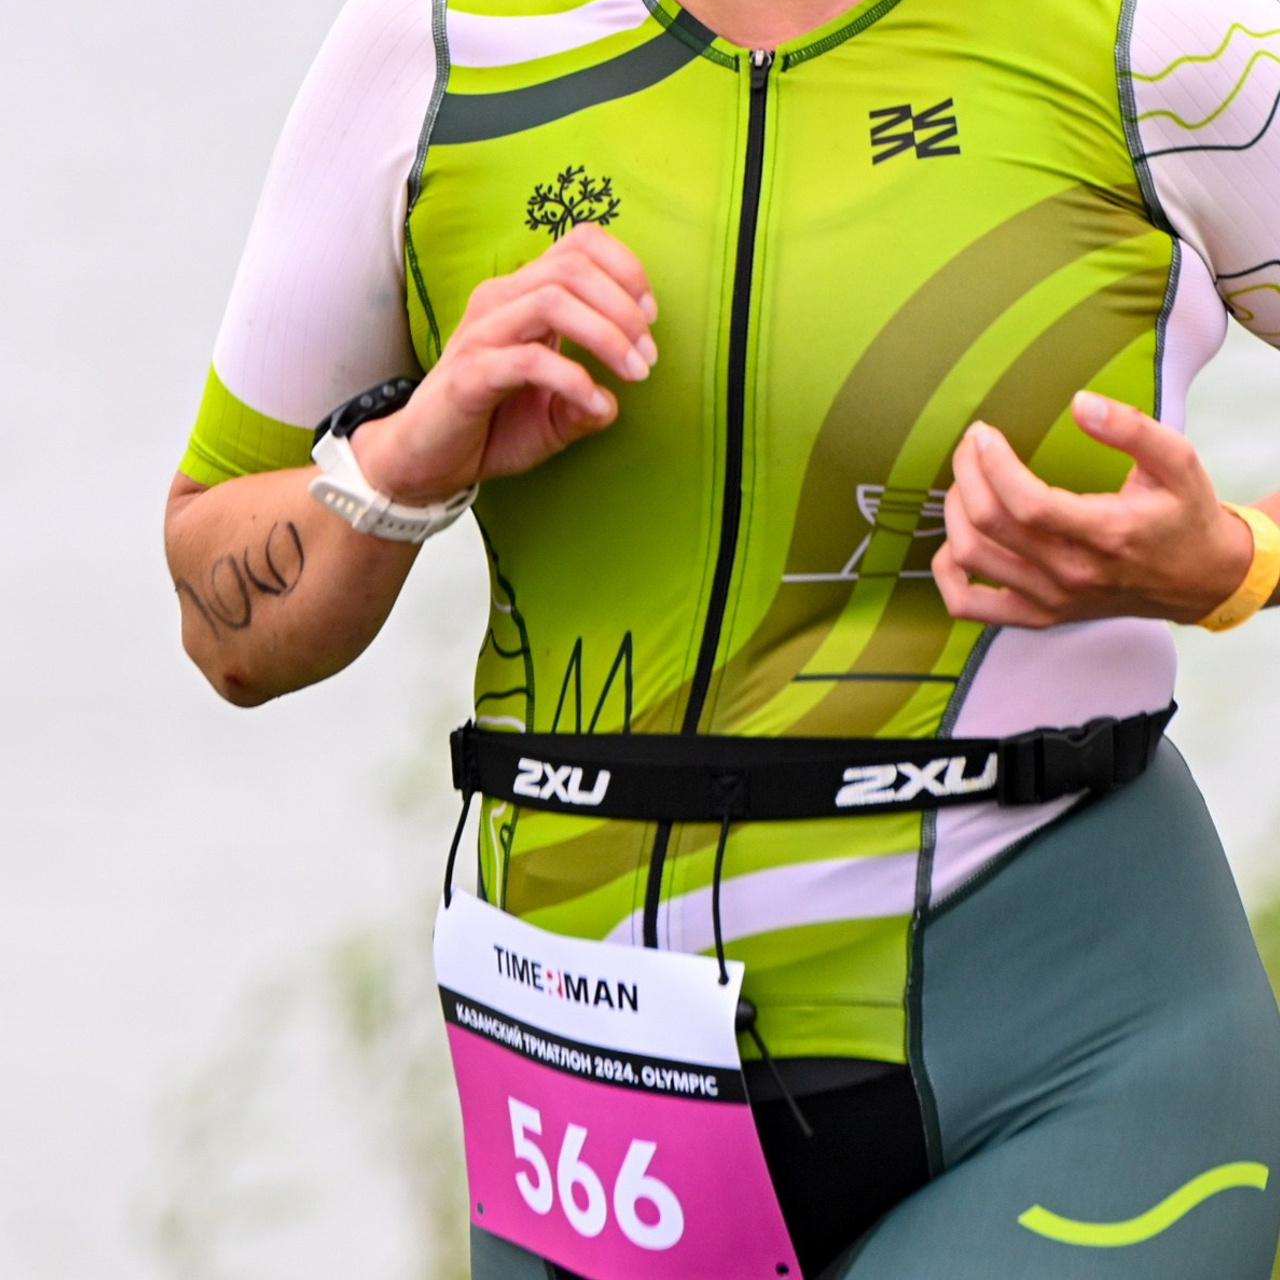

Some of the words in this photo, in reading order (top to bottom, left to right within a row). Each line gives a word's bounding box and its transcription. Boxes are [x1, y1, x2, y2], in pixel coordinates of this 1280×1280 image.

[513, 757, 611, 807] 2XU
[835, 751, 998, 808] 2XU
[455, 1001, 523, 1050] КАЗАНСКИЙ
[522, 1032, 592, 1075] ТРИАТЛОН
[641, 1065, 718, 1097] OLYMPIC
[508, 1095, 685, 1251] 566
